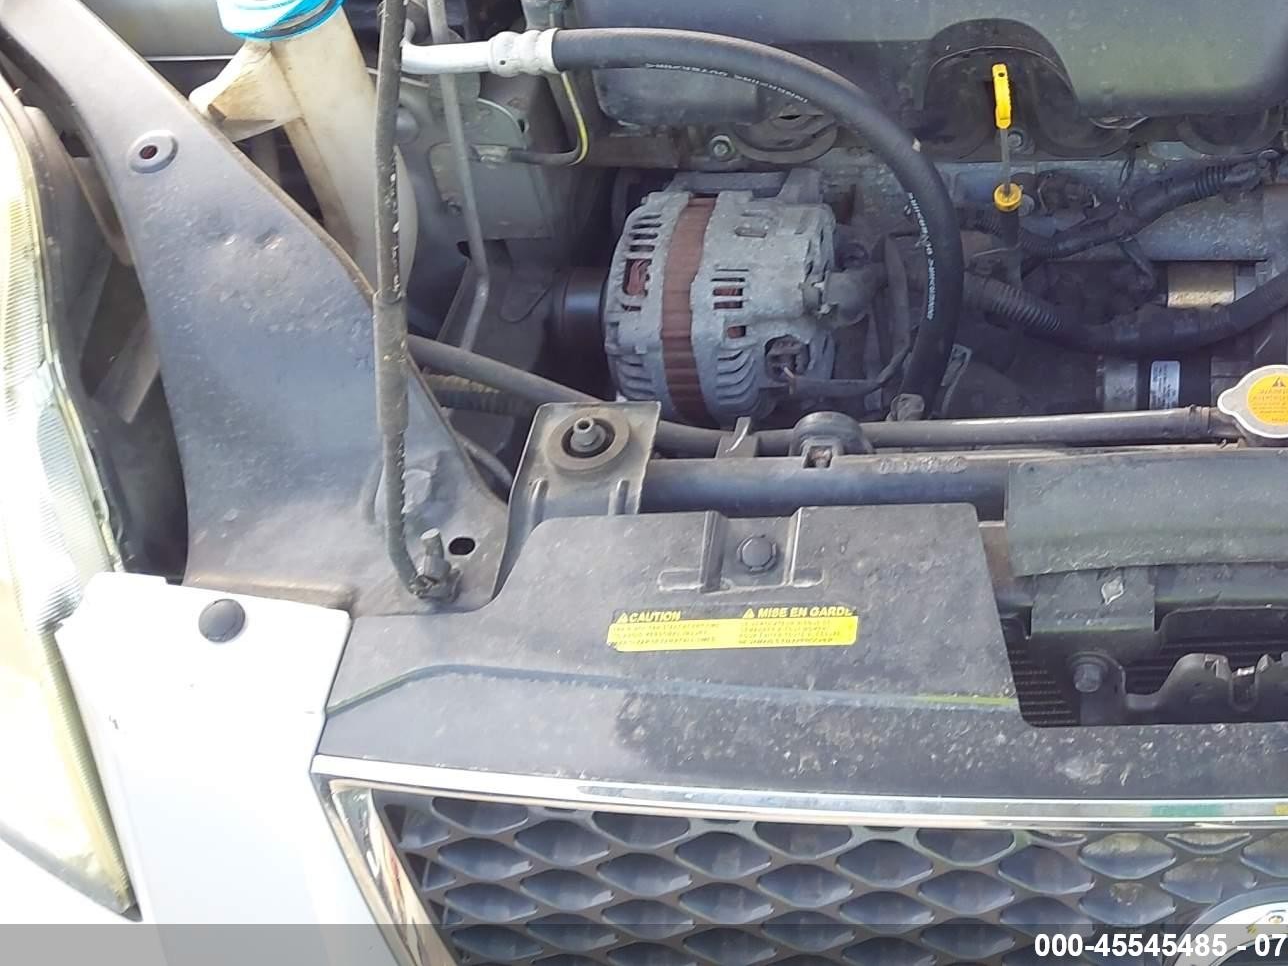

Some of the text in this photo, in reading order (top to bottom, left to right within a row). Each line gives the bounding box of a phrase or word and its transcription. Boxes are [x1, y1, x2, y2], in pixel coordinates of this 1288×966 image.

[628, 610, 682, 622] CAUTION
[757, 607, 788, 619] MISE
[789, 606, 807, 618] EN
